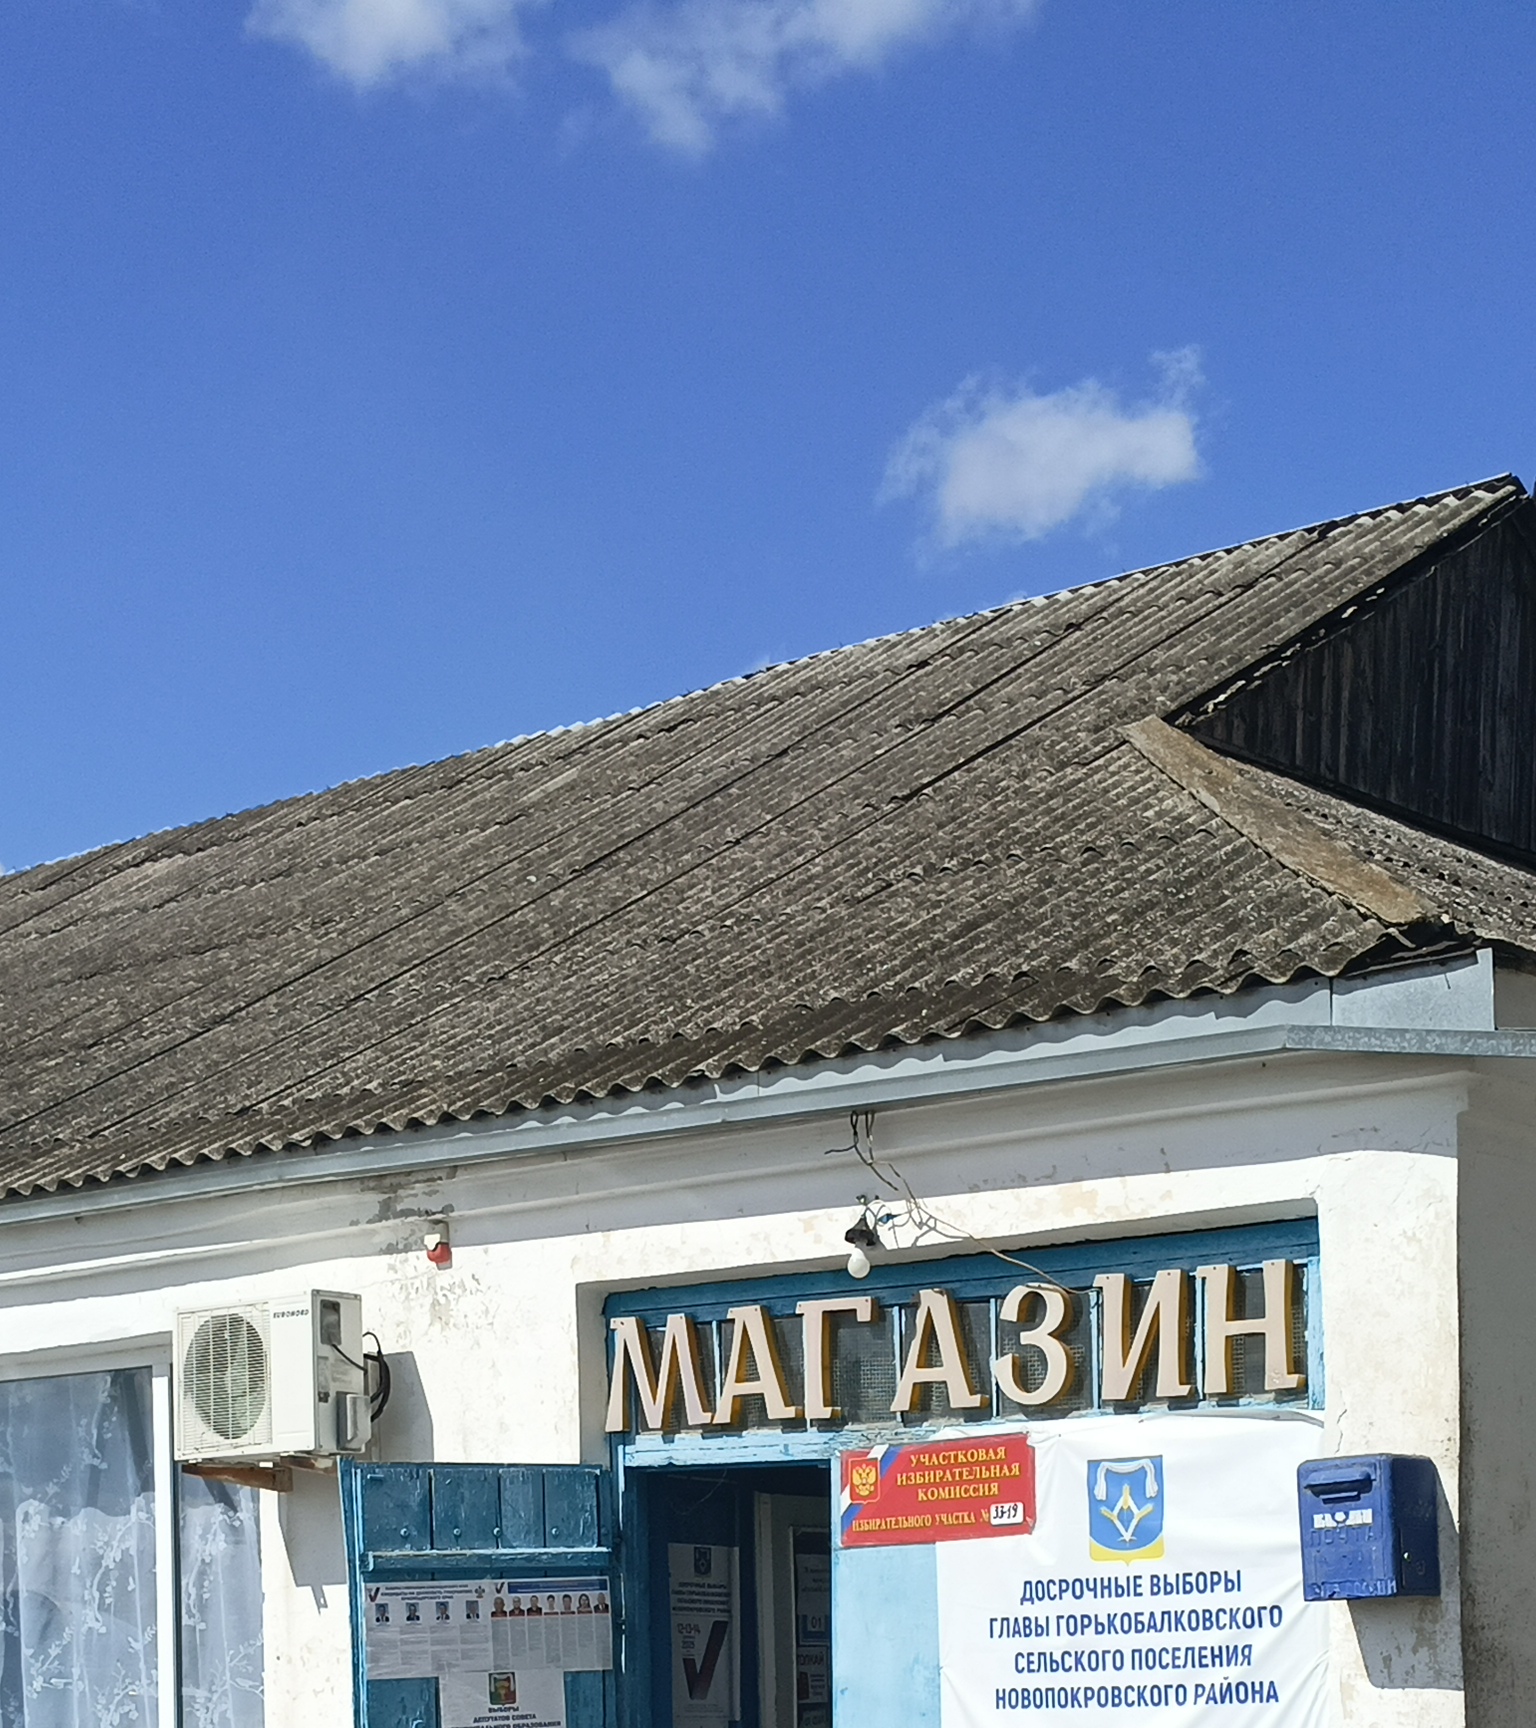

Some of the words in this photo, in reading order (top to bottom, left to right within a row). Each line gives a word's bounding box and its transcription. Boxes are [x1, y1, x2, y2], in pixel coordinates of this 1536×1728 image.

[604, 1258, 1307, 1433] МАГАЗИН
[910, 1447, 1006, 1468] УЧАСТКОВАЯ
[897, 1463, 1020, 1486] ИЗБИРАТЕЛЬНАЯ
[918, 1482, 999, 1502] КОМИССИЯ
[852, 1514, 932, 1532] ИЗБИРАТЕЛЬНОГО
[935, 1511, 976, 1526] УЧАСТКА
[1020, 1575, 1143, 1605] ДОСРОЧНЫЕ
[1150, 1569, 1242, 1596] ВЫБОРЫ
[989, 1616, 1050, 1639] ГЛАВЫ
[1056, 1604, 1283, 1637] ГОРЬКОБАЛКОВСКОГО
[1014, 1649, 1125, 1674] СЕЛЬСКОГО
[1131, 1644, 1253, 1671] ПОСЕЛЕНИЯ
[995, 1684, 1187, 1710] НОВОПОКРОВСКОГО
[1193, 1676, 1279, 1706] РАЙОНА
